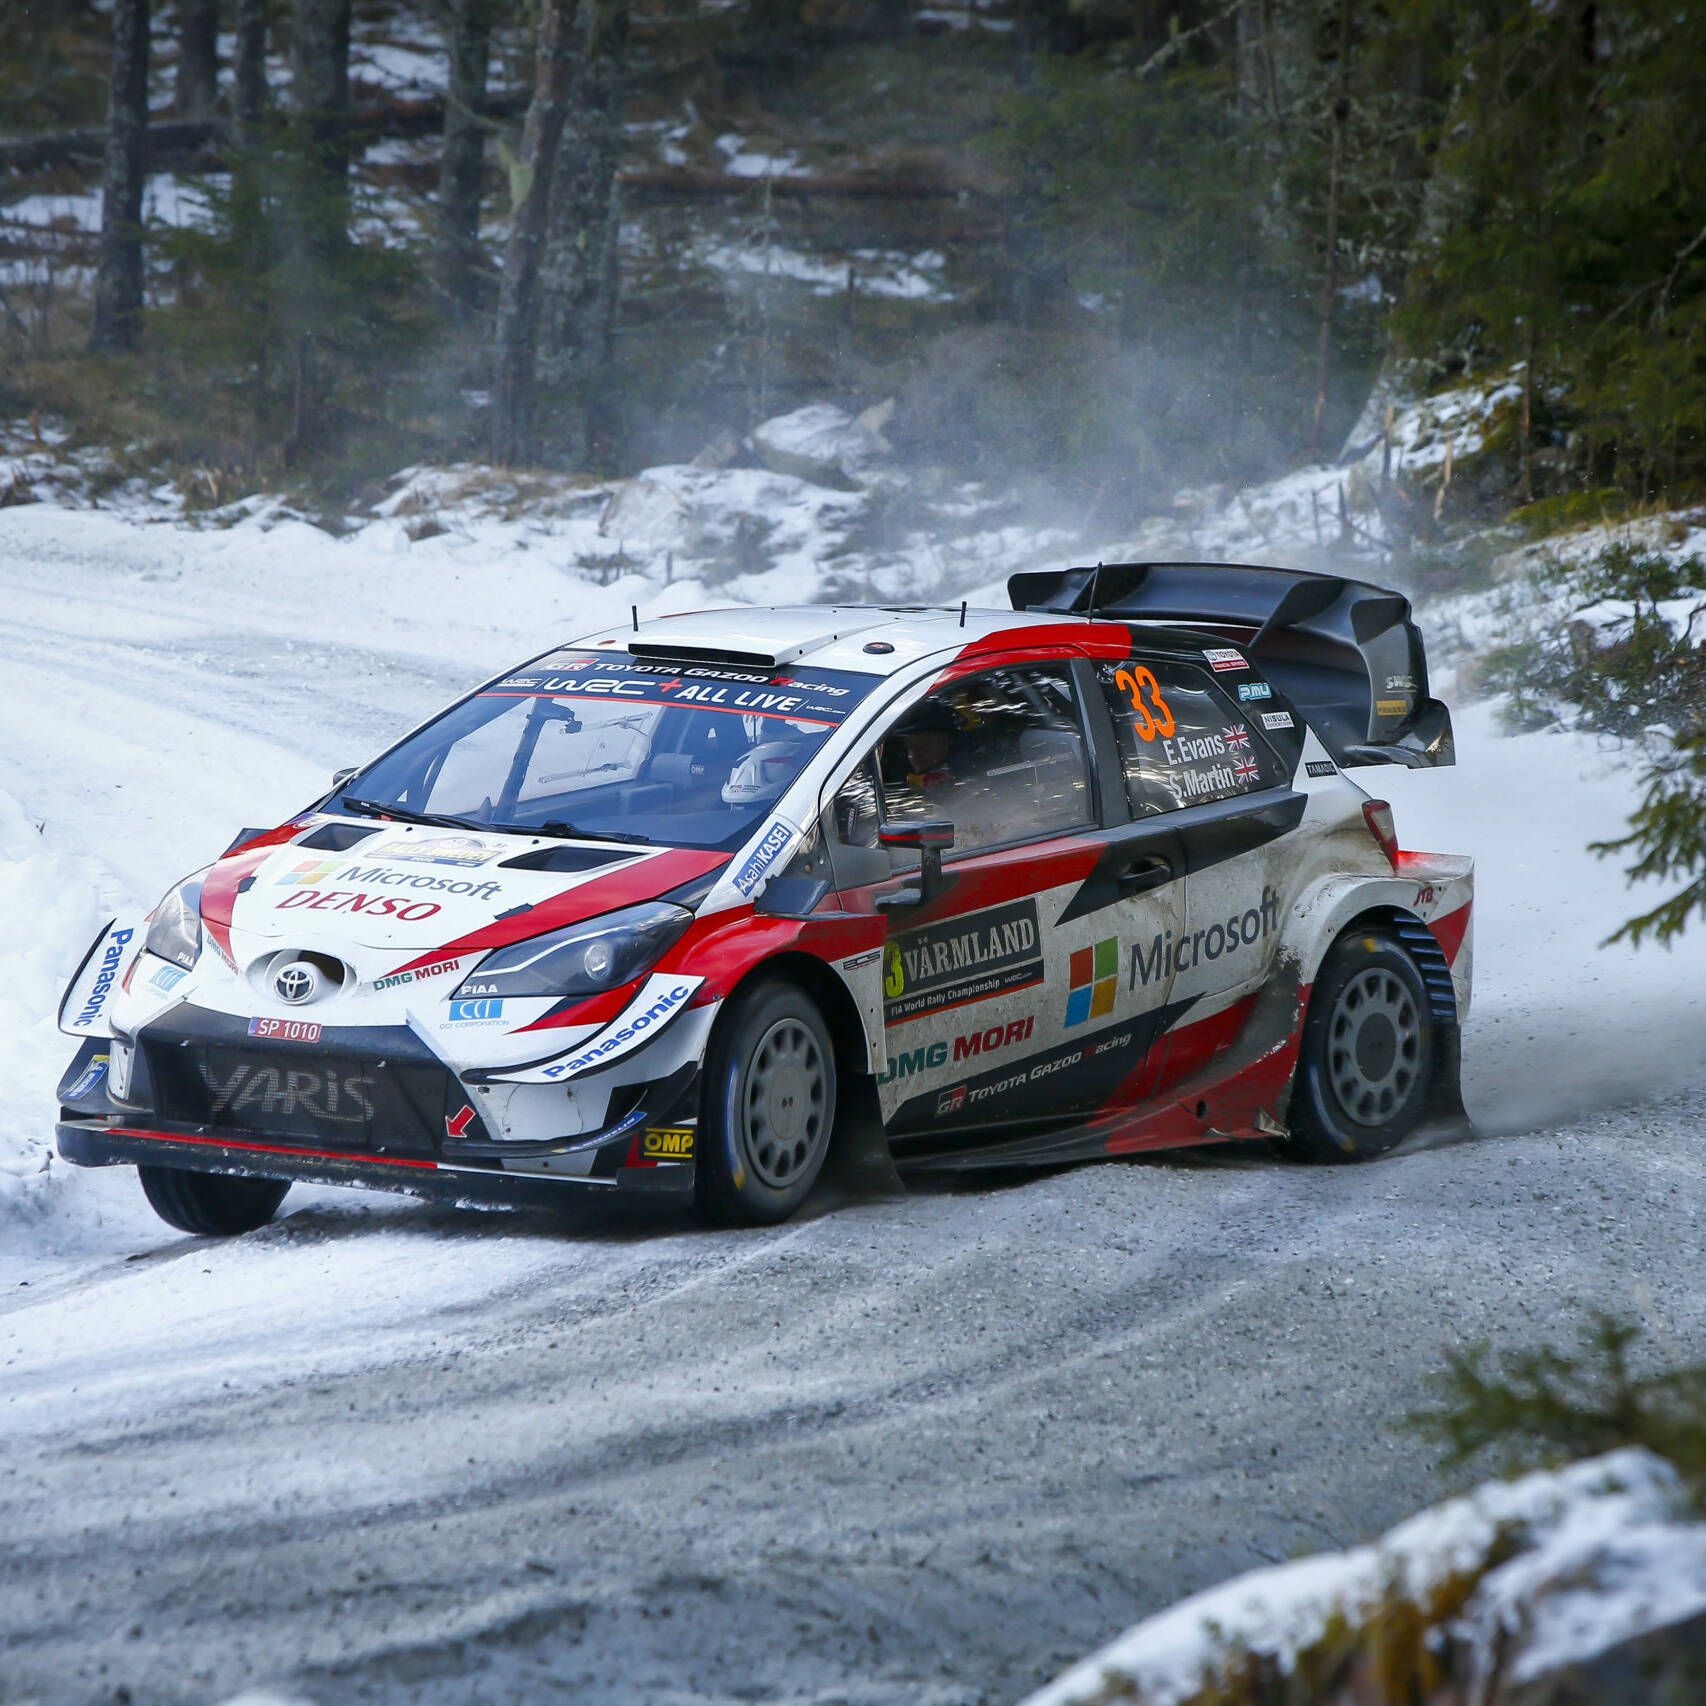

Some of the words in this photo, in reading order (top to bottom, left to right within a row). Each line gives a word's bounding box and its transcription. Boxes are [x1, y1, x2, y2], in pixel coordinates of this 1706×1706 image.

[593, 663, 682, 675] TOYOTA
[684, 667, 769, 684] GAZOO
[769, 677, 850, 697] Racing
[674, 685, 729, 703] ALL
[734, 691, 802, 712] LIVE
[1115, 665, 1176, 742] 33
[1263, 714, 1290, 723] NISULA
[1162, 733, 1226, 766] E.Evans
[1168, 762, 1236, 800] S.Martin
[736, 824, 791, 894] AsahiKASEI
[335, 865, 503, 901] Microsoft
[274, 889, 442, 921] DENSO
[904, 918, 1035, 982] VÄRMLAND
[1128, 884, 1281, 992] Microsoft
[72, 927, 135, 1027] Panasonic
[372, 971, 413, 992] DMG
[415, 959, 460, 981] MORI
[461, 984, 499, 995] PIAA
[891, 1005, 904, 1017] FIA
[904, 999, 926, 1013] World
[927, 993, 946, 1007] Rally
[947, 978, 1001, 1001] Championship
[256, 1020, 280, 1037] SP
[282, 1021, 319, 1041] 1010
[541, 984, 690, 1079] Panasonic
[876, 1040, 949, 1086] DMG
[952, 1015, 1035, 1062] MORI
[199, 1063, 375, 1124] YARIS
[937, 1094, 964, 1117] GR
[968, 1075, 1027, 1103] TOYOTA
[1030, 1051, 1082, 1079] GAZOO
[1084, 1032, 1133, 1058] Racing
[644, 1133, 694, 1153] OMP
